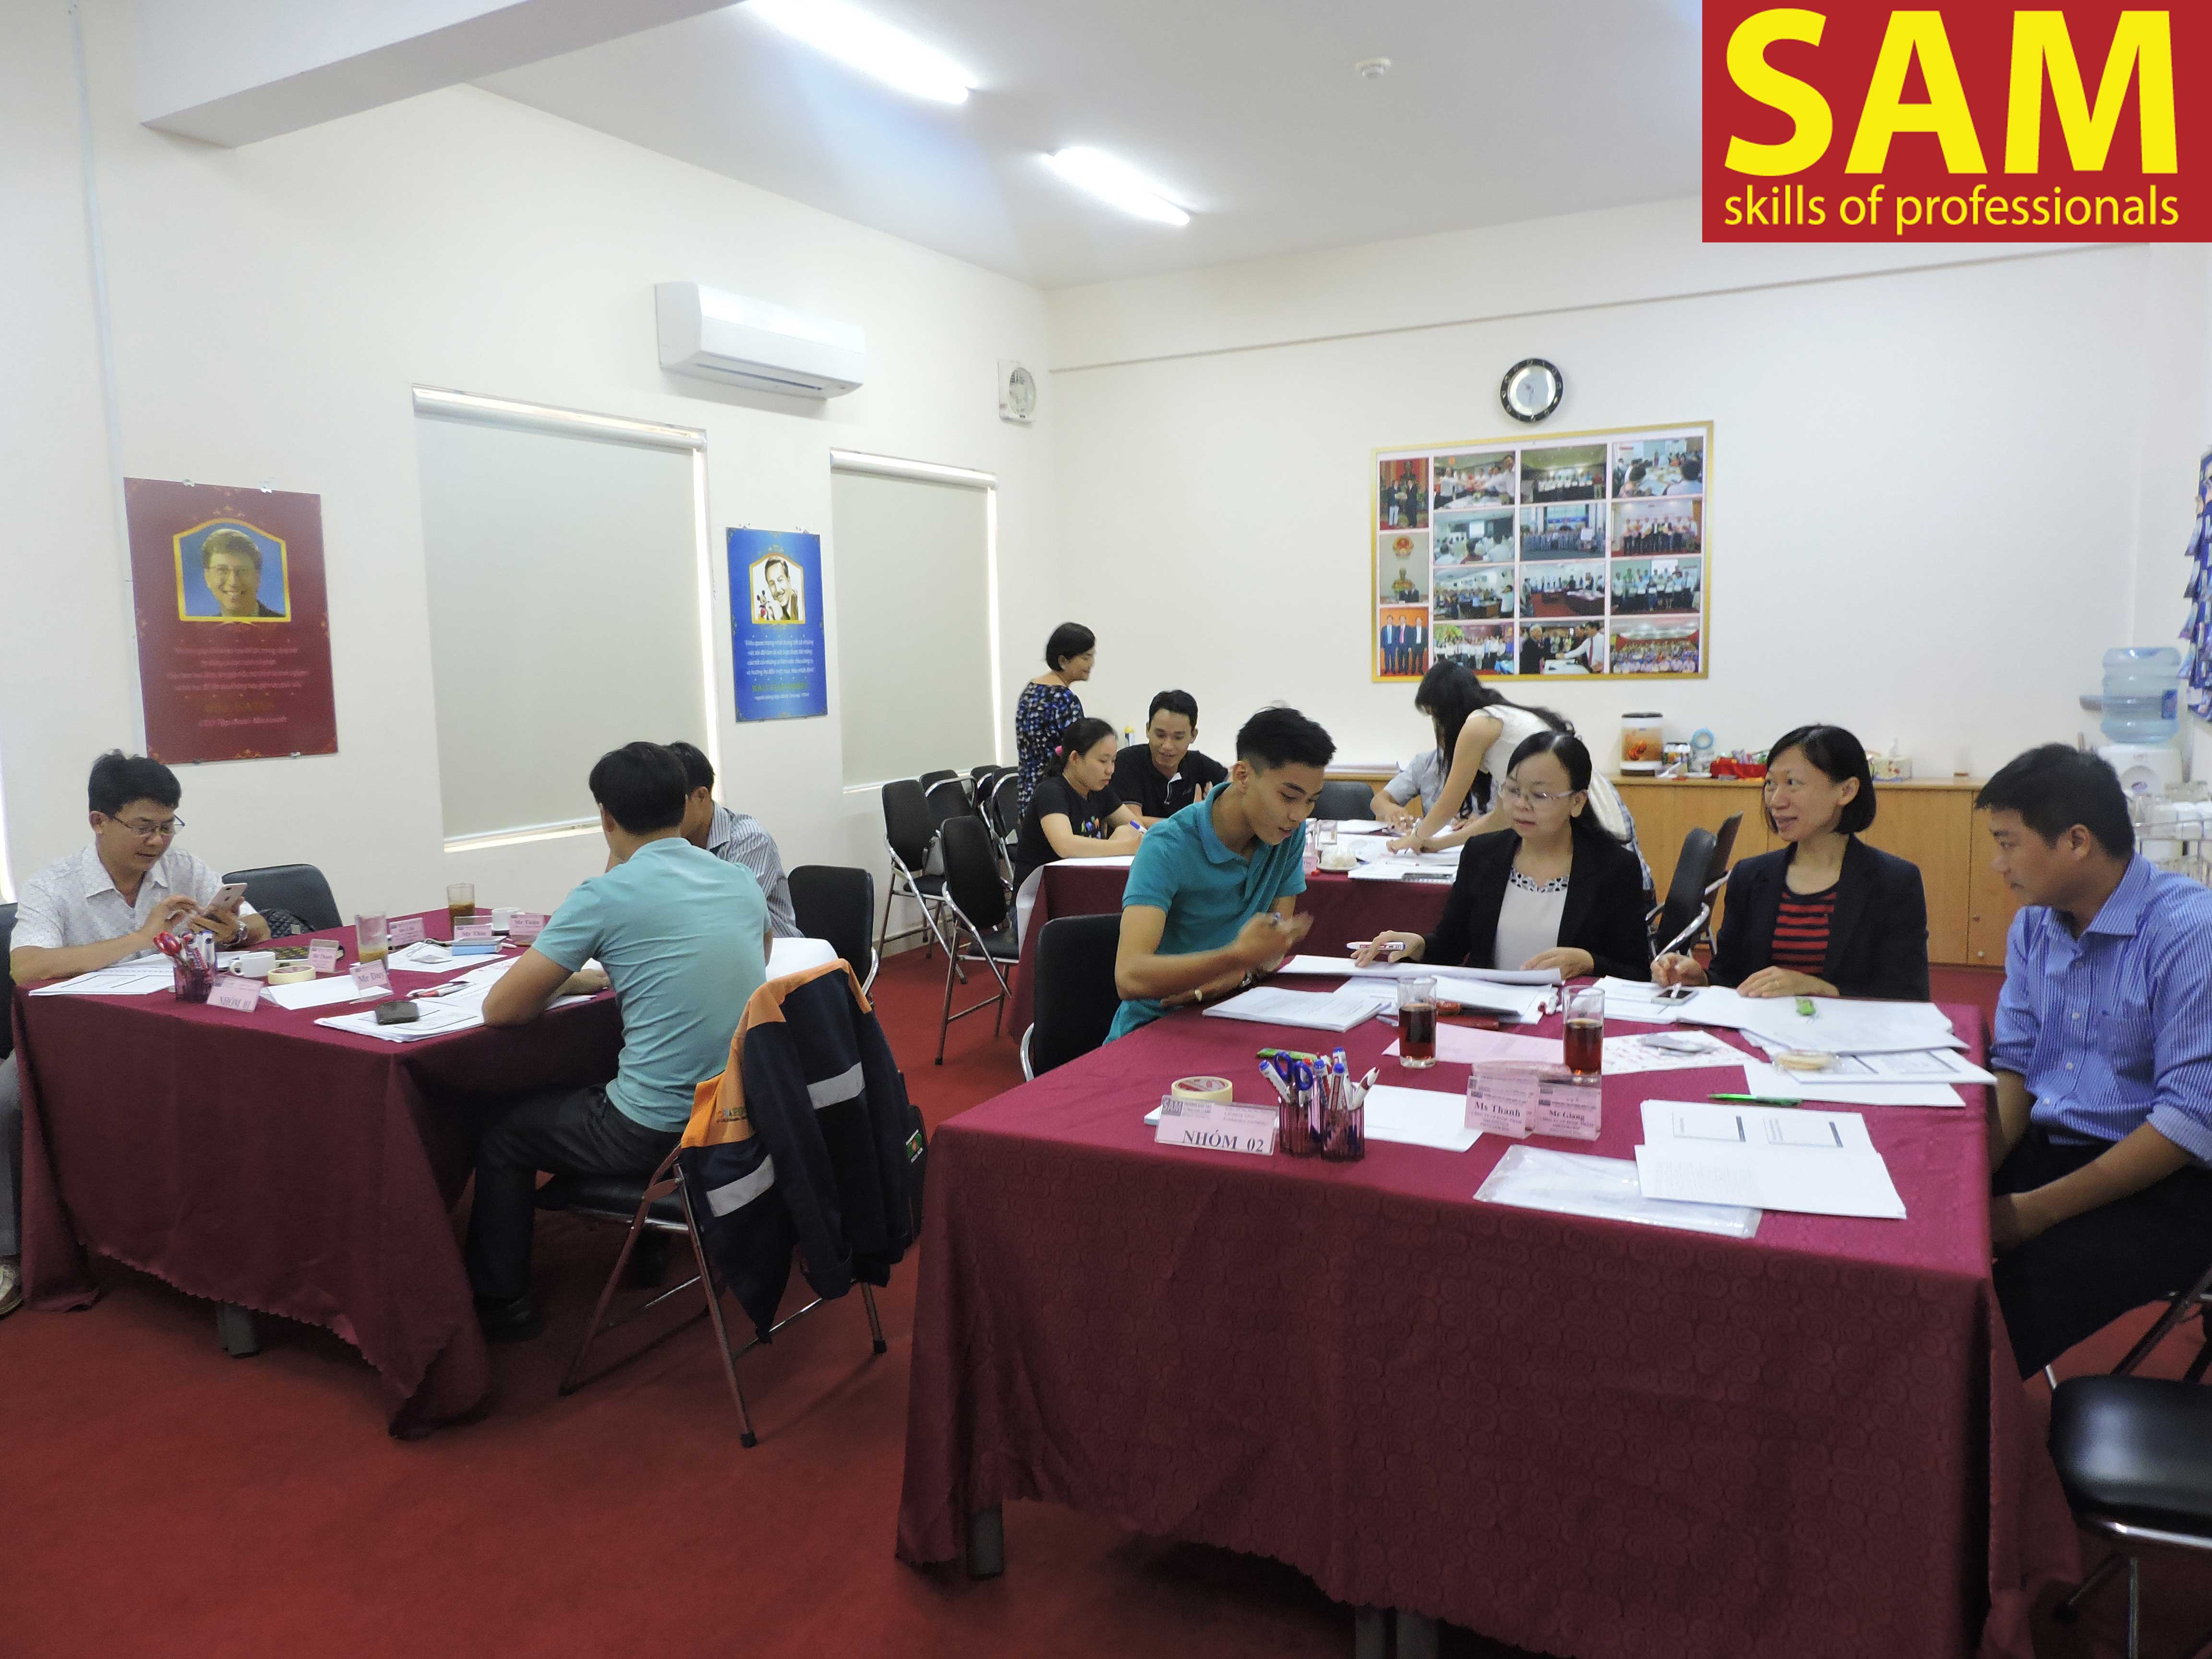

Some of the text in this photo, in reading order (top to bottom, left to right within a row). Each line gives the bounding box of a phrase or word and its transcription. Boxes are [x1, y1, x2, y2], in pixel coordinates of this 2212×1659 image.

[1163, 1099, 1182, 1113] SAM
[1475, 1101, 1520, 1117] Ms Thanh
[1563, 1111, 1585, 1121] Giang
[1183, 1129, 1263, 1152] NHÓM 02
